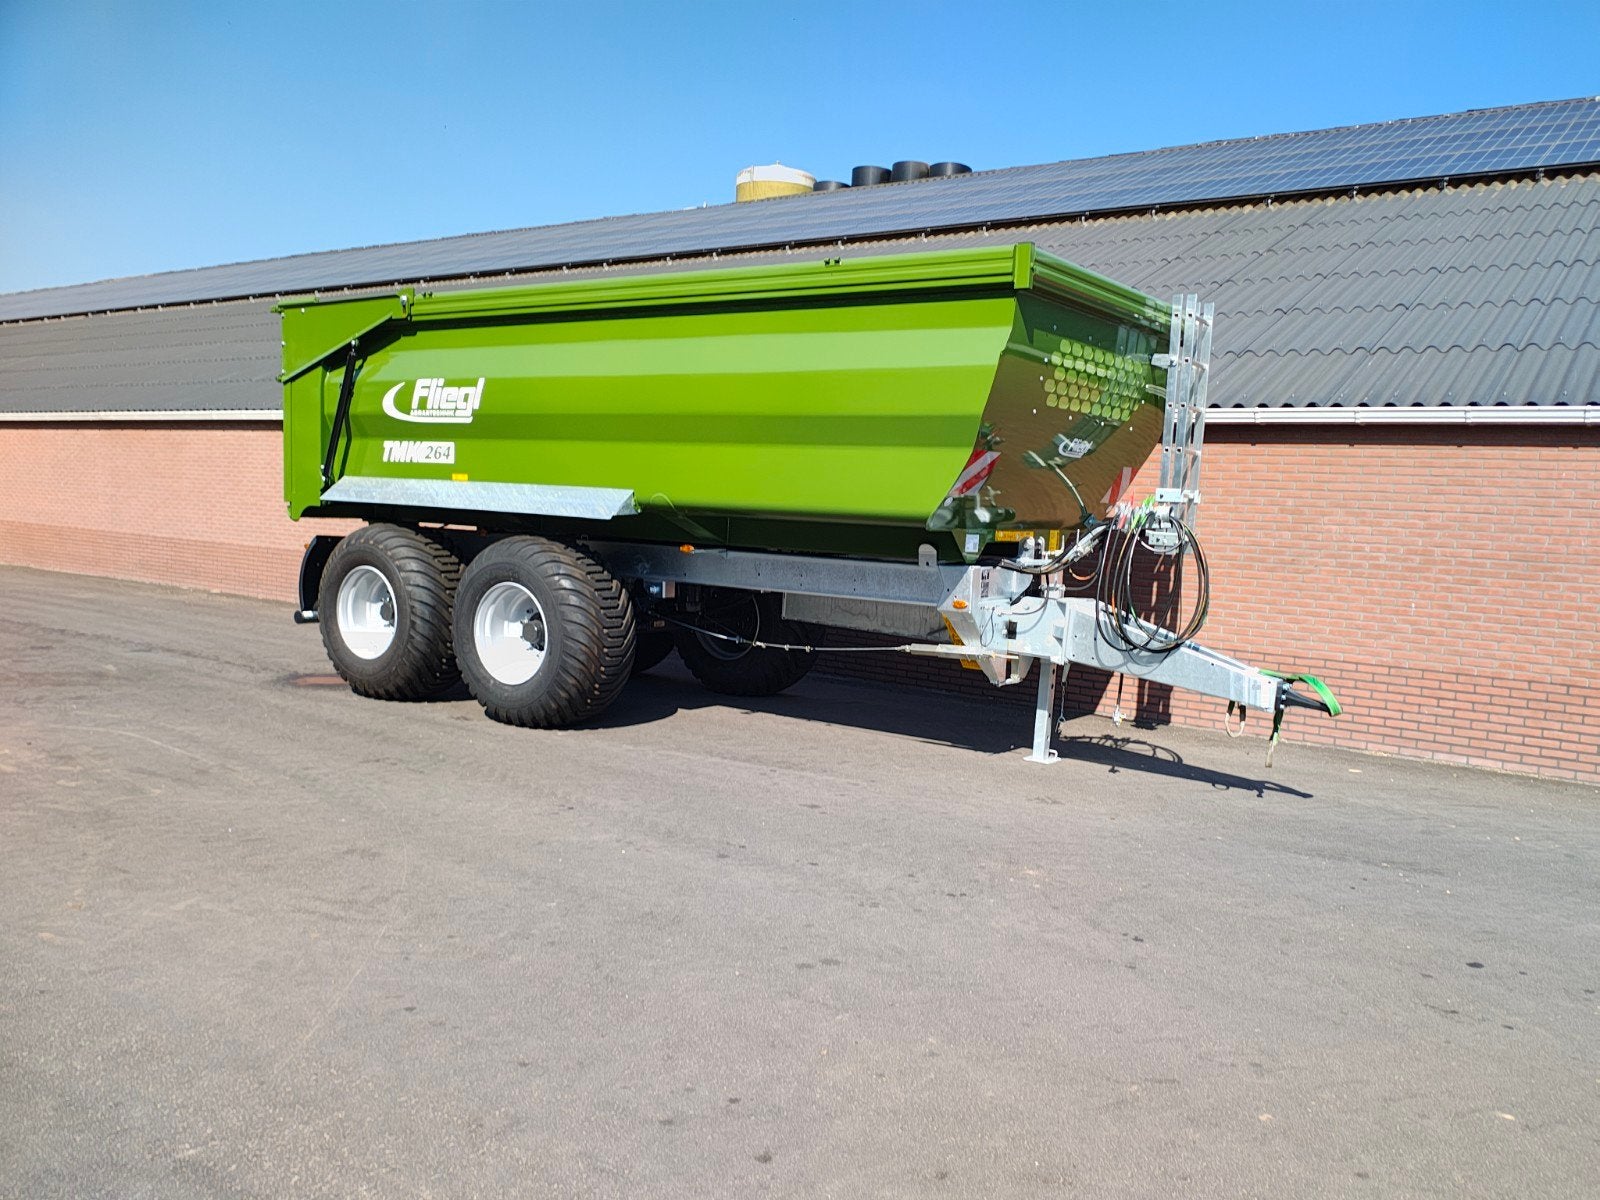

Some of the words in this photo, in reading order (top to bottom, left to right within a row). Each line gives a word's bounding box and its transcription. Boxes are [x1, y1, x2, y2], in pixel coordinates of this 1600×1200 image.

[411, 377, 485, 417] Fliegl
[383, 440, 422, 463] TMK
[424, 445, 452, 460] 264
